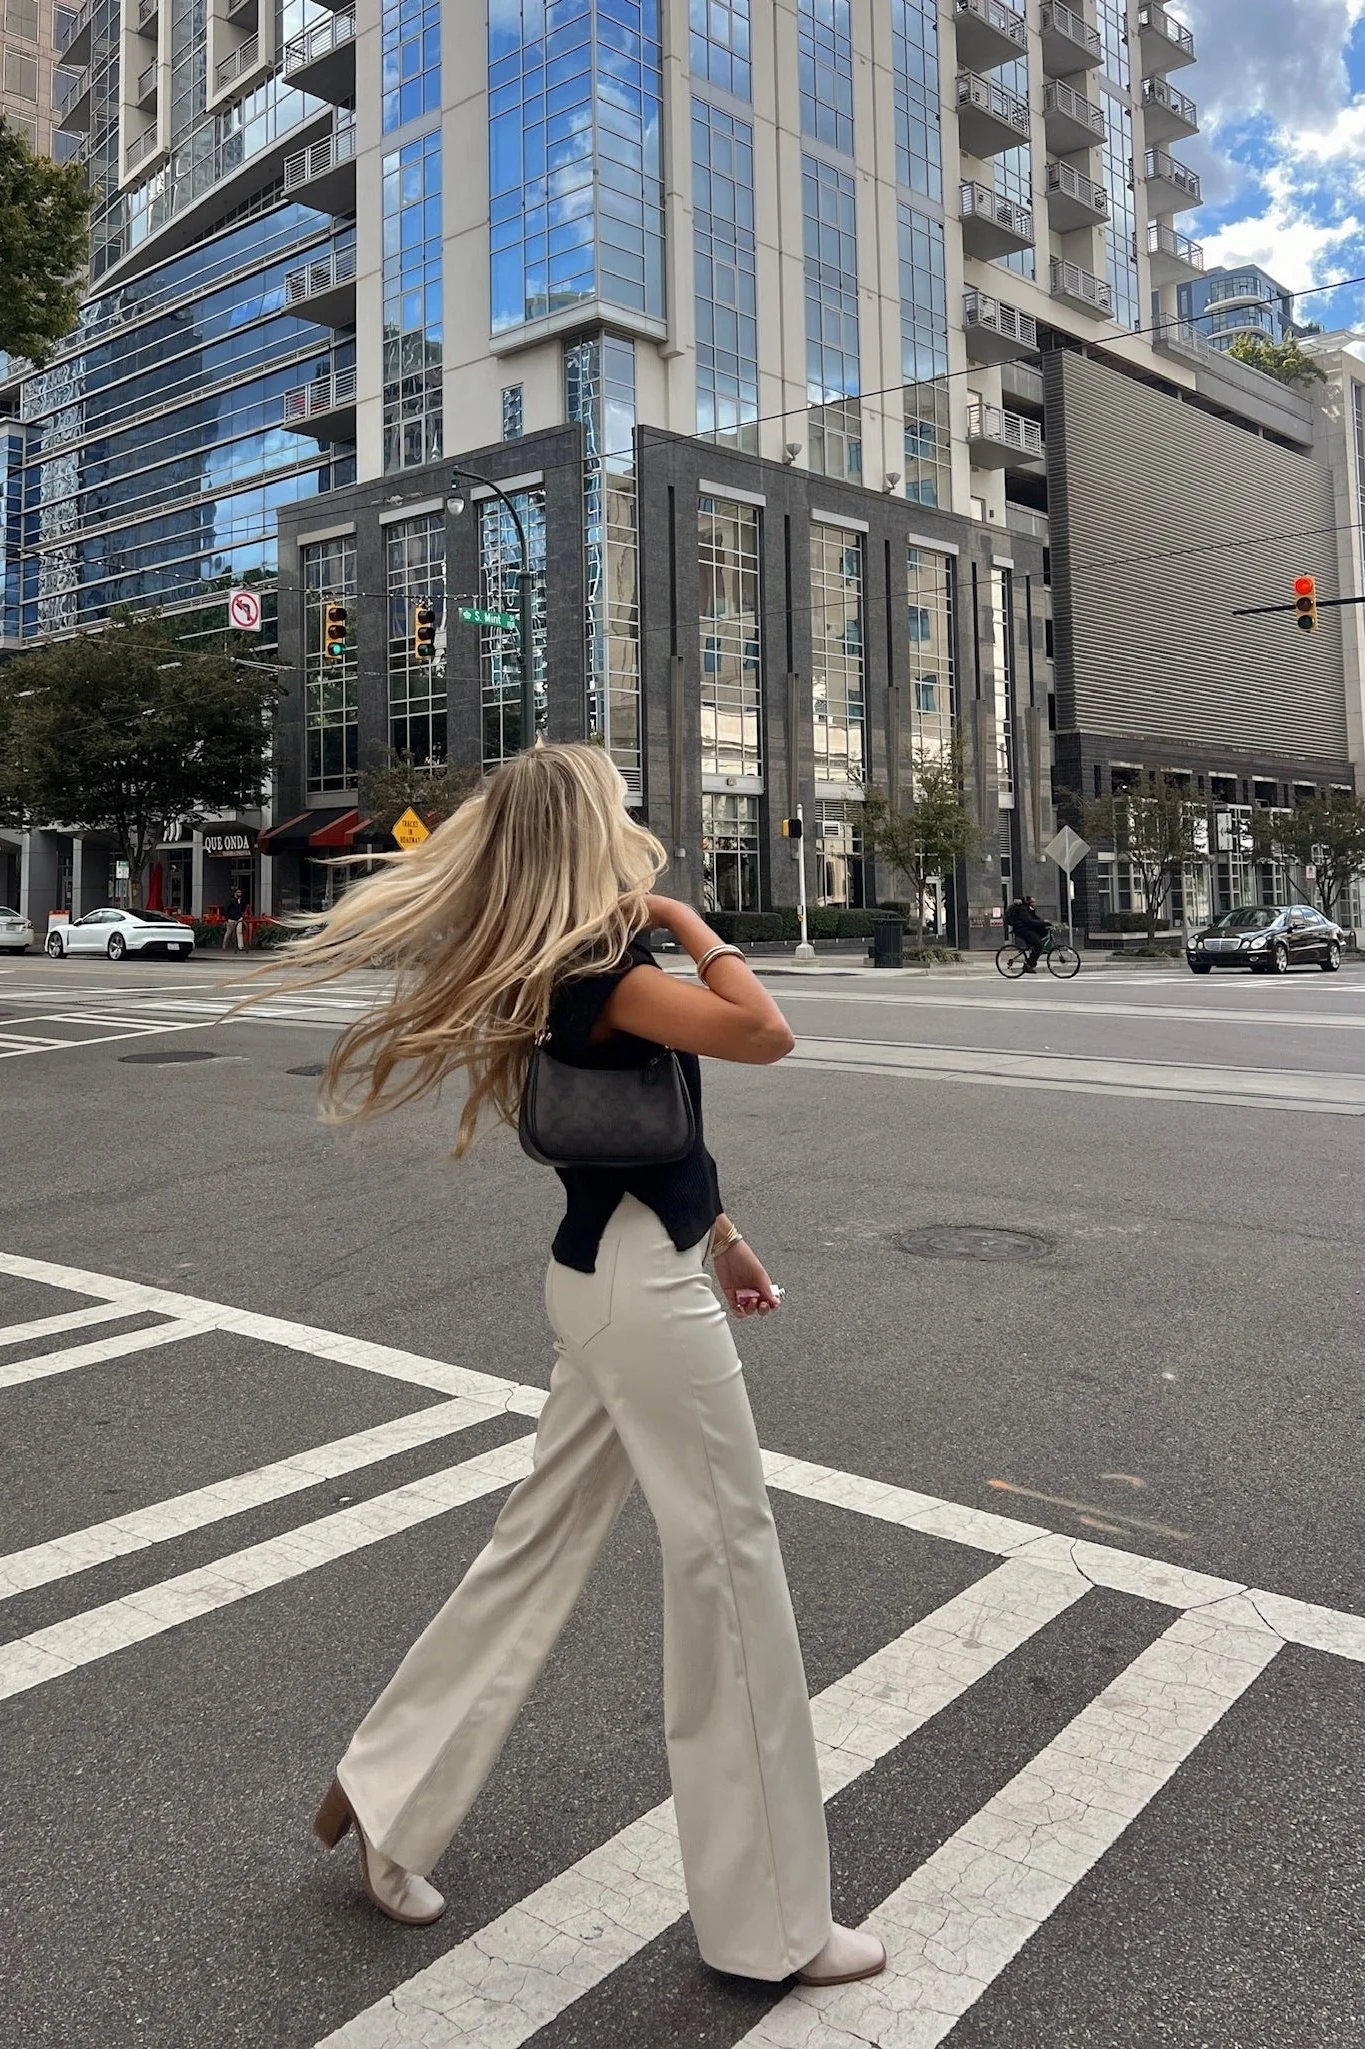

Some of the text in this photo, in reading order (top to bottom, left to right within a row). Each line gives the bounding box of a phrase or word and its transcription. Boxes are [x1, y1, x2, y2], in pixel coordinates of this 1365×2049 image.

[474, 611, 482, 622] S.
[484, 612, 502, 625] Mint
[204, 835, 250, 853] QUE ONDA
